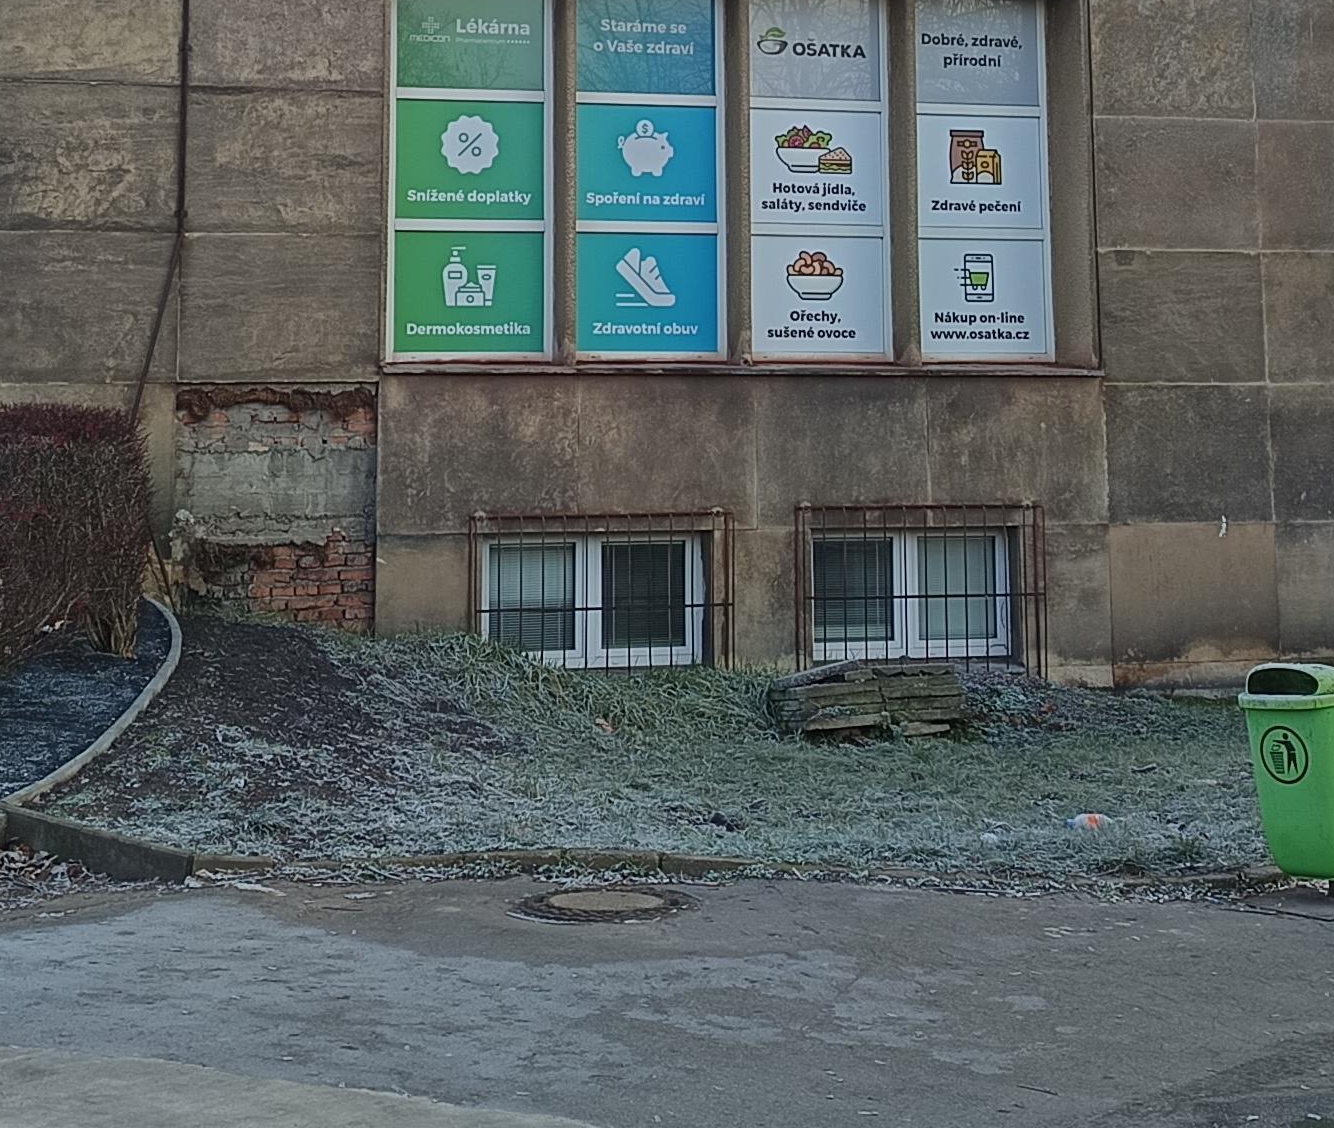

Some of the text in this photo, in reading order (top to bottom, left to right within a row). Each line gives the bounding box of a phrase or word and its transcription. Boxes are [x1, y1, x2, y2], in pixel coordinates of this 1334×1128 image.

[455, 17, 531, 36] Lékárna
[600, 19, 687, 34] Staráme se
[593, 39, 695, 55] o Vaše zdraví
[792, 38, 867, 59] OŠATKA
[921, 32, 1023, 50] Dobré, zdravé,
[942, 53, 1002, 68] přírodní
[407, 189, 532, 206] Snížené doplatky
[772, 182, 856, 198] Hotová jídla,
[585, 191, 706, 206] Spoření na zdraví
[761, 198, 867, 213] saláty, sendviče
[931, 199, 1022, 215] Zdravé pečení
[789, 310, 842, 324] Ořechy,
[934, 311, 1026, 326] Nákup on-line
[406, 322, 531, 336] Dermokosmetika
[593, 321, 699, 335] Zdravotní obuv
[766, 326, 857, 340] sušené ovoce
[930, 327, 1031, 341] www.osatka.cz
